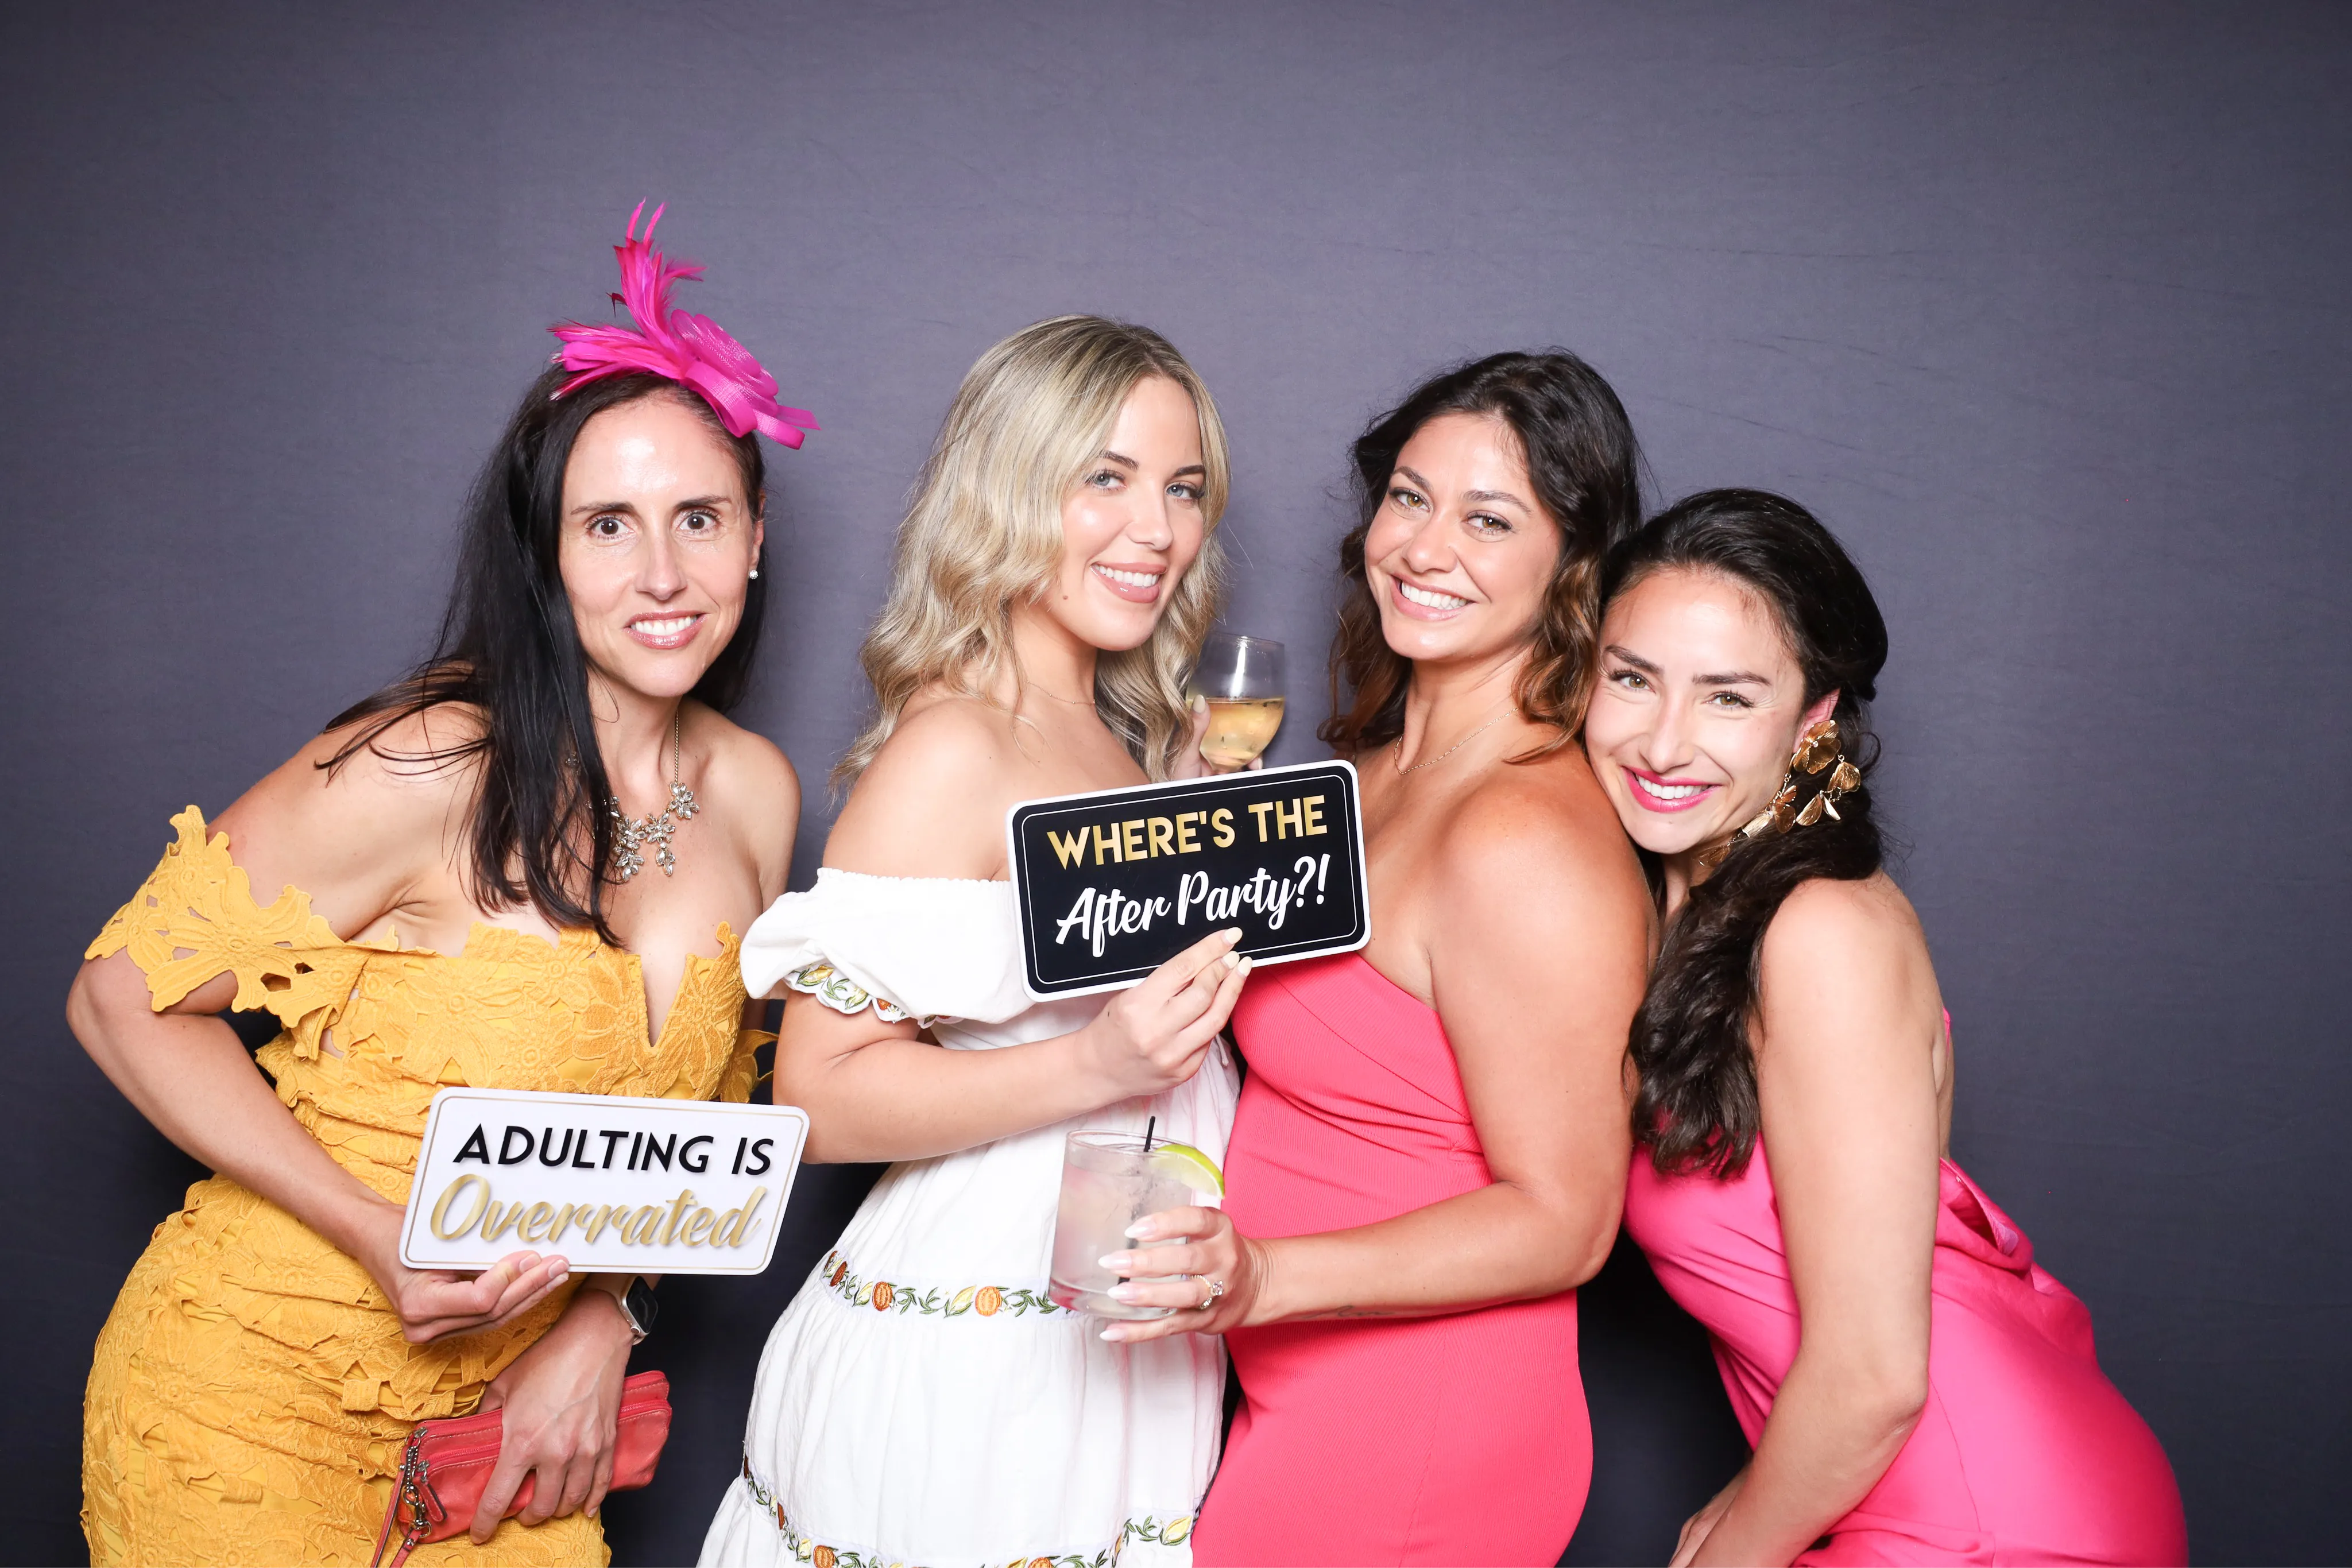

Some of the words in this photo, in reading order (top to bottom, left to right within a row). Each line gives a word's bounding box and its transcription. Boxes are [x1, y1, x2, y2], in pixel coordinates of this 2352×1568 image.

[1047, 808, 1236, 870] WHERE'S
[1248, 795, 1328, 842] THE
[1055, 886, 1172, 958] After
[1177, 853, 1331, 931] Party?!
[453, 1123, 714, 1174] ADULTING
[731, 1137, 774, 1176] IS
[430, 1173, 768, 1248] Overrated
